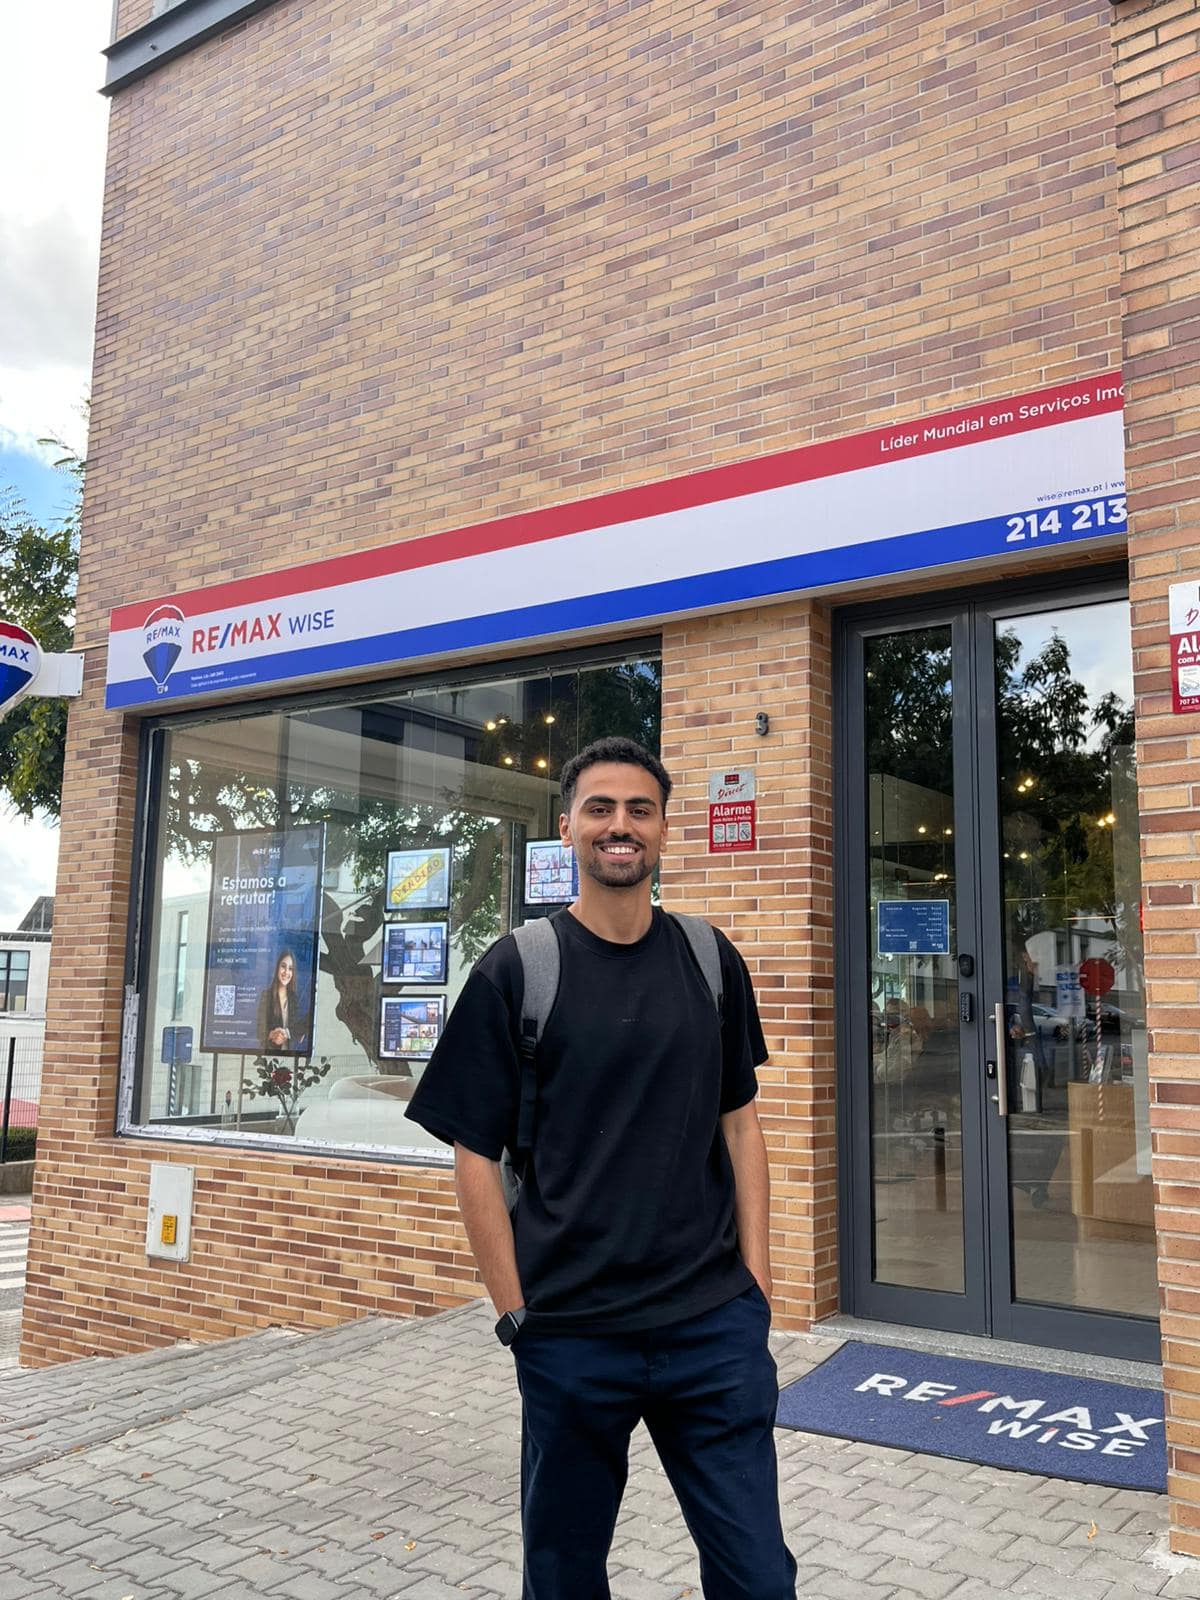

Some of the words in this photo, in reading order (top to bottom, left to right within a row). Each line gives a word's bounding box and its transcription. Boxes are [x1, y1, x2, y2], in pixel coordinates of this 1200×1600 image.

[880, 433, 919, 452] Líder
[923, 415, 984, 441] Mundial
[989, 410, 1013, 427] em
[1019, 393, 1091, 420] Serviços
[1006, 509, 1062, 543] 214
[1071, 497, 1127, 531] 213
[146, 625, 181, 645] RE/MAX
[191, 612, 282, 655] RE/MAX
[288, 609, 335, 635] WISE
[1177, 634, 1200, 655] Al
[1178, 655, 1194, 665] com
[713, 804, 752, 817] Alarme
[222, 876, 274, 890] Estamos
[278, 876, 287, 888] a
[220, 889, 276, 906] recrutar!
[853, 1372, 1164, 1439] RE/MAX
